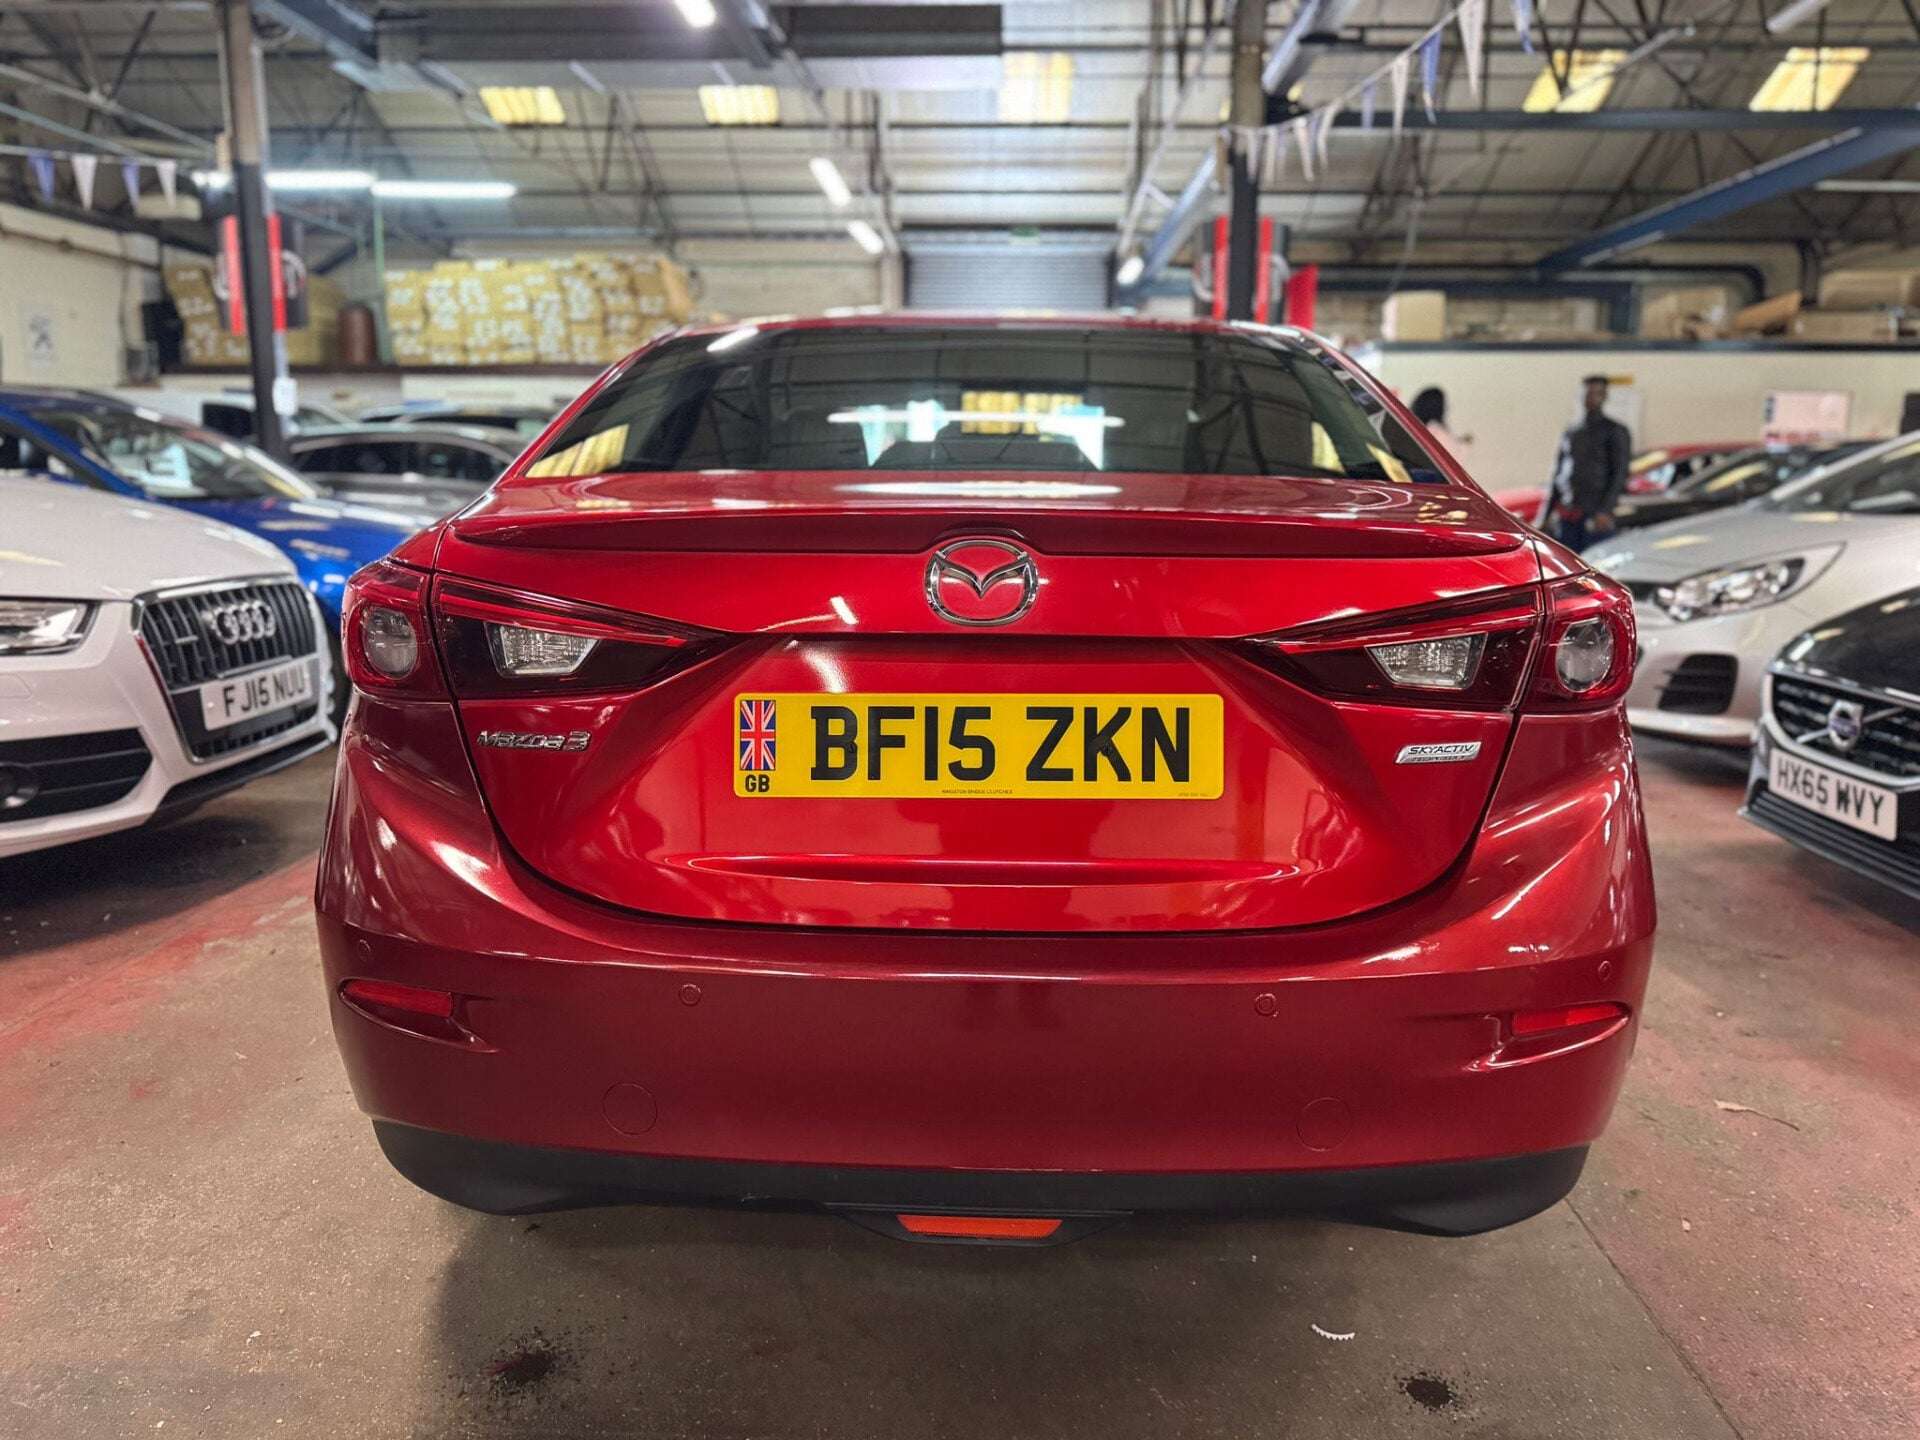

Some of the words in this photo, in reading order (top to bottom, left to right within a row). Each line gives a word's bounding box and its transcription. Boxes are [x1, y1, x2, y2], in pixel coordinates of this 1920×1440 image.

[222, 676, 270, 717] FJ15
[811, 706, 996, 780] BF15
[1026, 707, 1190, 782] ZKN
[1408, 745, 1475, 755] SKYACTIV
[745, 774, 770, 792] GB
[1777, 758, 1829, 805] HX65
